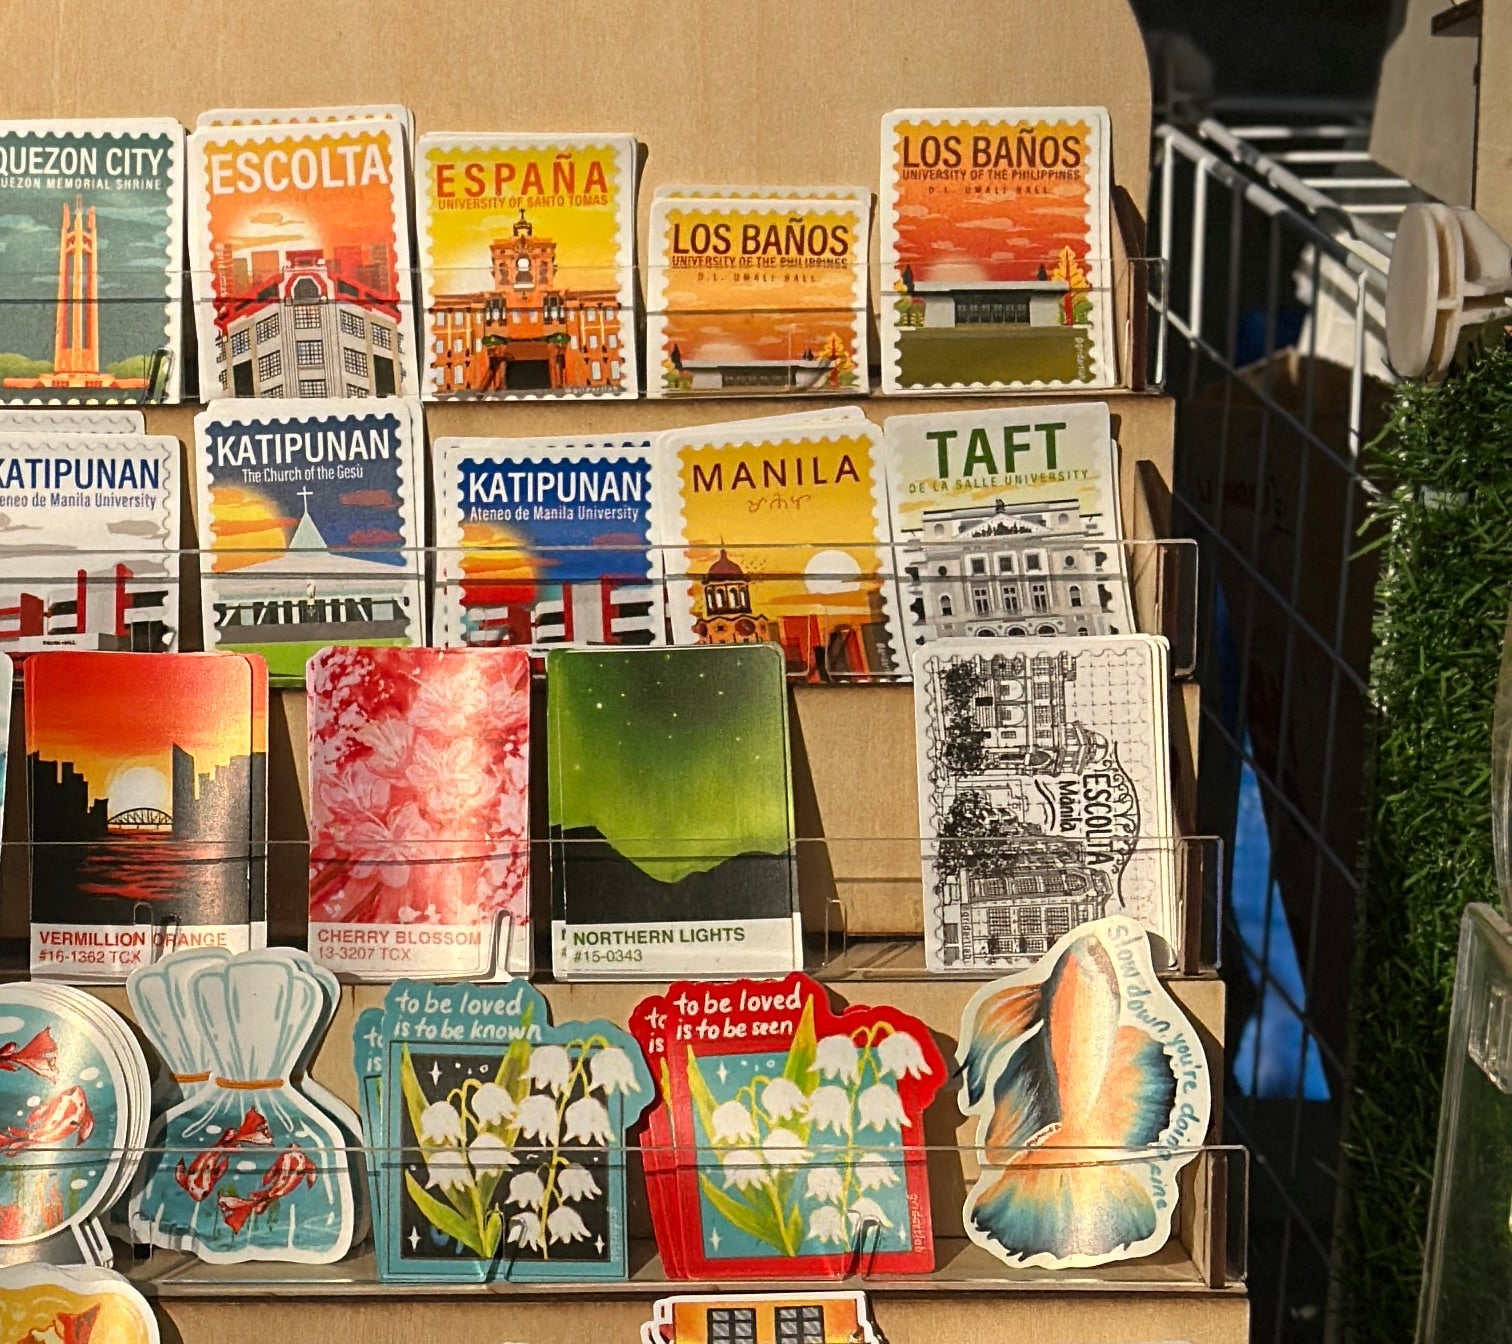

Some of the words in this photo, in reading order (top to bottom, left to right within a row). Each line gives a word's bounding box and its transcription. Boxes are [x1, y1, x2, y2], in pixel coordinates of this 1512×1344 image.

[903, 135, 962, 169] LOS
[972, 127, 1082, 170] BAÑOS
[106, 147, 164, 177] CITY
[211, 143, 389, 195] ESCOLTA
[46, 178, 111, 190] MEMORIAL
[115, 179, 162, 191] SHRINE
[436, 152, 608, 198] ESPAÑA
[902, 169, 967, 181] UNIVERSITY
[969, 169, 985, 181] OF
[987, 169, 1008, 181] THE
[1011, 169, 1082, 181] PHILIPPINES
[438, 197, 506, 210] UNIVERSITY
[508, 197, 524, 208] OF
[527, 195, 565, 207] SANTO
[568, 194, 608, 206] TOMAS
[673, 223, 731, 255] LOS
[742, 217, 849, 256] BAÑOS
[217, 429, 390, 467] KATIPUNAN
[926, 422, 1067, 479] TAFT
[242, 468, 262, 484] The
[264, 467, 302, 483] Church
[304, 467, 316, 481] of
[317, 466, 335, 480] the
[692, 455, 860, 493] MANILA
[909, 483, 926, 494] DE
[932, 480, 948, 492] LA
[955, 476, 998, 489] SALLE
[1004, 469, 1089, 486] UNIVERSITY
[469, 472, 642, 503] KATIPUNAN
[31, 493, 46, 506] de
[50, 493, 91, 507] Manila
[95, 493, 156, 511] University
[470, 507, 511, 522] Ateneo
[515, 507, 530, 521] de
[533, 506, 574, 521] Manila
[577, 506, 639, 523] University
[1058, 779, 1079, 834] Manila
[1082, 772, 1116, 866] ESCOLTA
[39, 931, 145, 947] VERMILLION
[153, 932, 228, 947] ORANGE
[317, 929, 390, 944] CHERRY
[395, 930, 482, 946] BLOSSOM
[573, 929, 674, 946] NORTHERN
[679, 927, 745, 943] LIGHTS
[38, 950, 105, 964] #16-1362
[111, 950, 141, 964] TCX
[318, 947, 375, 961] 13-3207
[379, 947, 411, 961] TCX
[573, 948, 643, 963] #15-0343
[395, 987, 420, 1014] to
[425, 987, 453, 1015] be
[460, 987, 524, 1016] loved
[673, 992, 699, 1016] to
[704, 989, 734, 1015] be
[739, 982, 802, 1013] loved
[393, 1017, 411, 1038] is
[414, 1019, 437, 1040] to
[441, 1017, 465, 1040] be
[470, 1017, 542, 1042] known
[676, 1019, 692, 1040] is
[696, 1019, 719, 1040] to
[723, 1017, 748, 1039] be
[751, 1019, 794, 1037] seen
